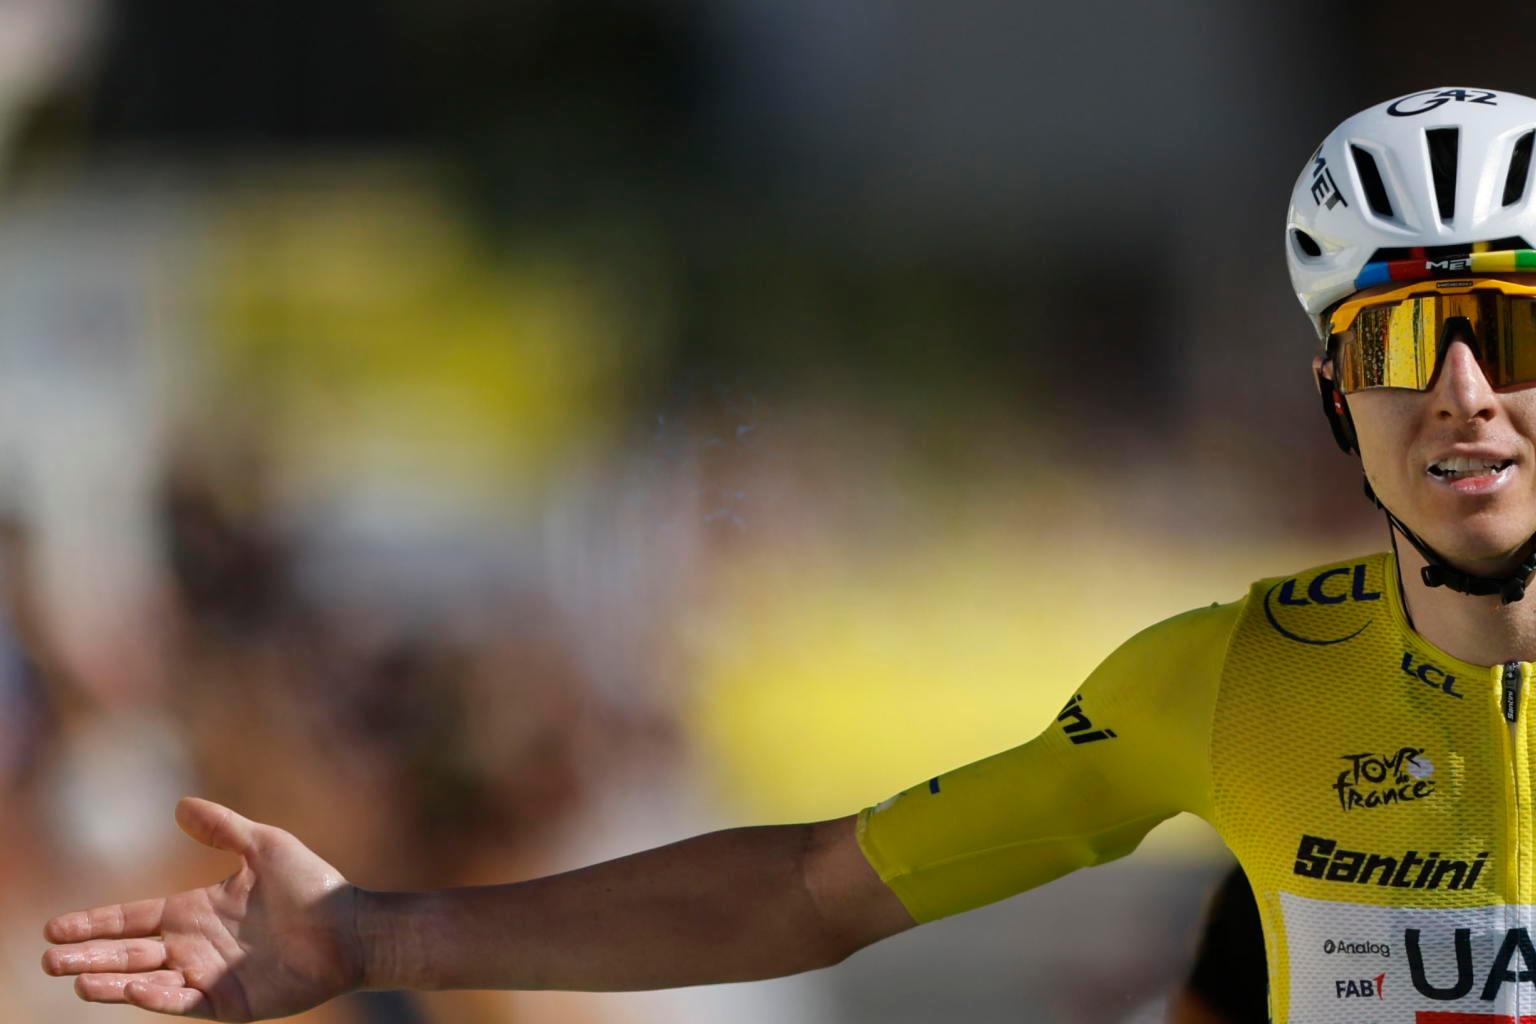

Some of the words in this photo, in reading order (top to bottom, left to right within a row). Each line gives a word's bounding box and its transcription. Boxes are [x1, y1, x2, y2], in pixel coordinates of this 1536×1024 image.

[1387, 89, 1497, 118] G42
[1310, 144, 1348, 210] MET
[1425, 258, 1472, 271] MET
[1277, 563, 1381, 606] LCL
[1401, 652, 1464, 700] LCL
[1293, 835, 1489, 891] Santini
[1337, 940, 1391, 958] Analog
